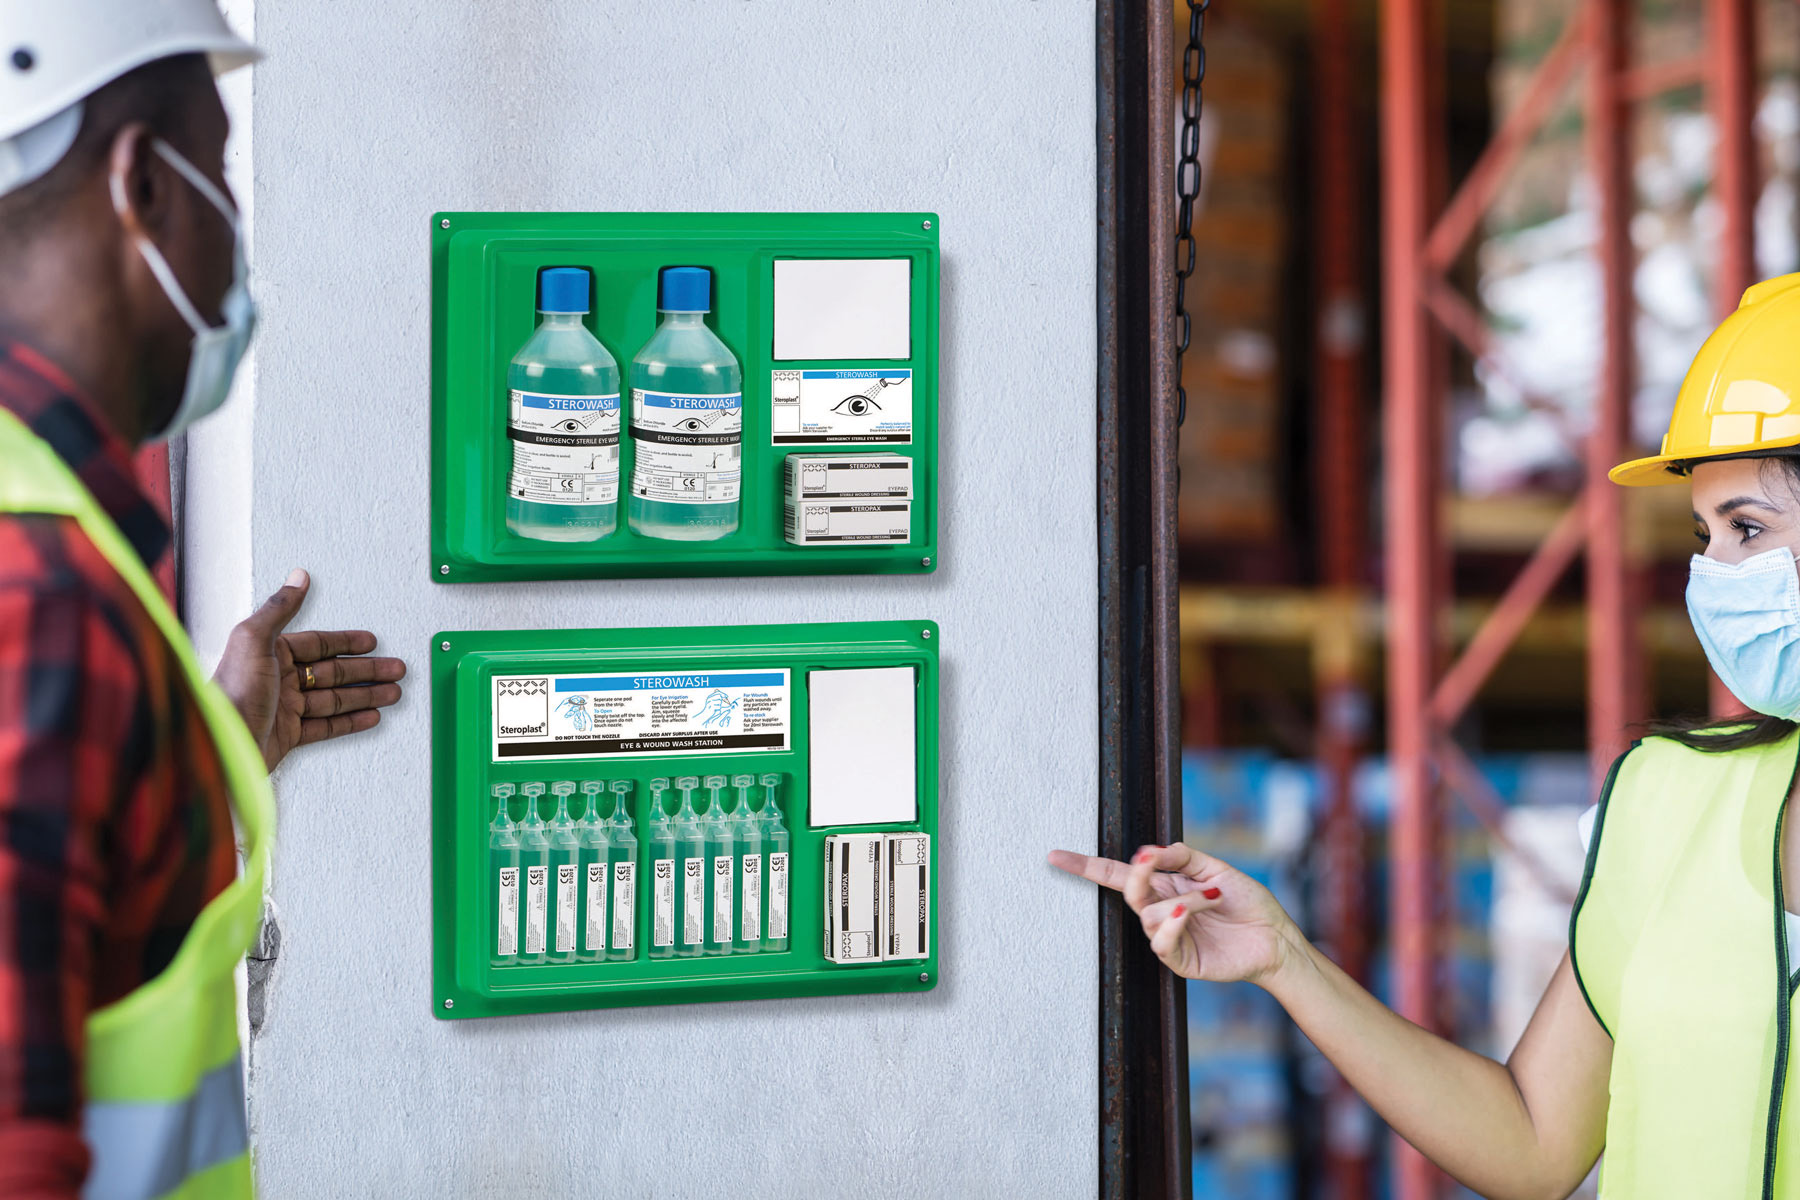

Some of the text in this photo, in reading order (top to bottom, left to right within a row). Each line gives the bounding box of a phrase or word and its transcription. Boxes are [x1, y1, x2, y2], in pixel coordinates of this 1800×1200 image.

[548, 399, 614, 410] STEROWASH
[670, 398, 735, 409] STEROWASH
[536, 436, 574, 444] EMERGENCY
[658, 435, 696, 443] EMERGENCY
[561, 480, 574, 488] CE
[683, 478, 695, 486] CE
[634, 676, 710, 689] STEROWASH
[687, 866, 695, 876] CE
[717, 864, 725, 875] CE
[745, 862, 753, 873] CE
[772, 860, 780, 871] CE
[560, 872, 568, 883] CE
[590, 871, 598, 882] CE
[617, 870, 625, 881] CE
[657, 867, 665, 878] CE
[502, 875, 510, 886] CE
[530, 874, 538, 885] CE
